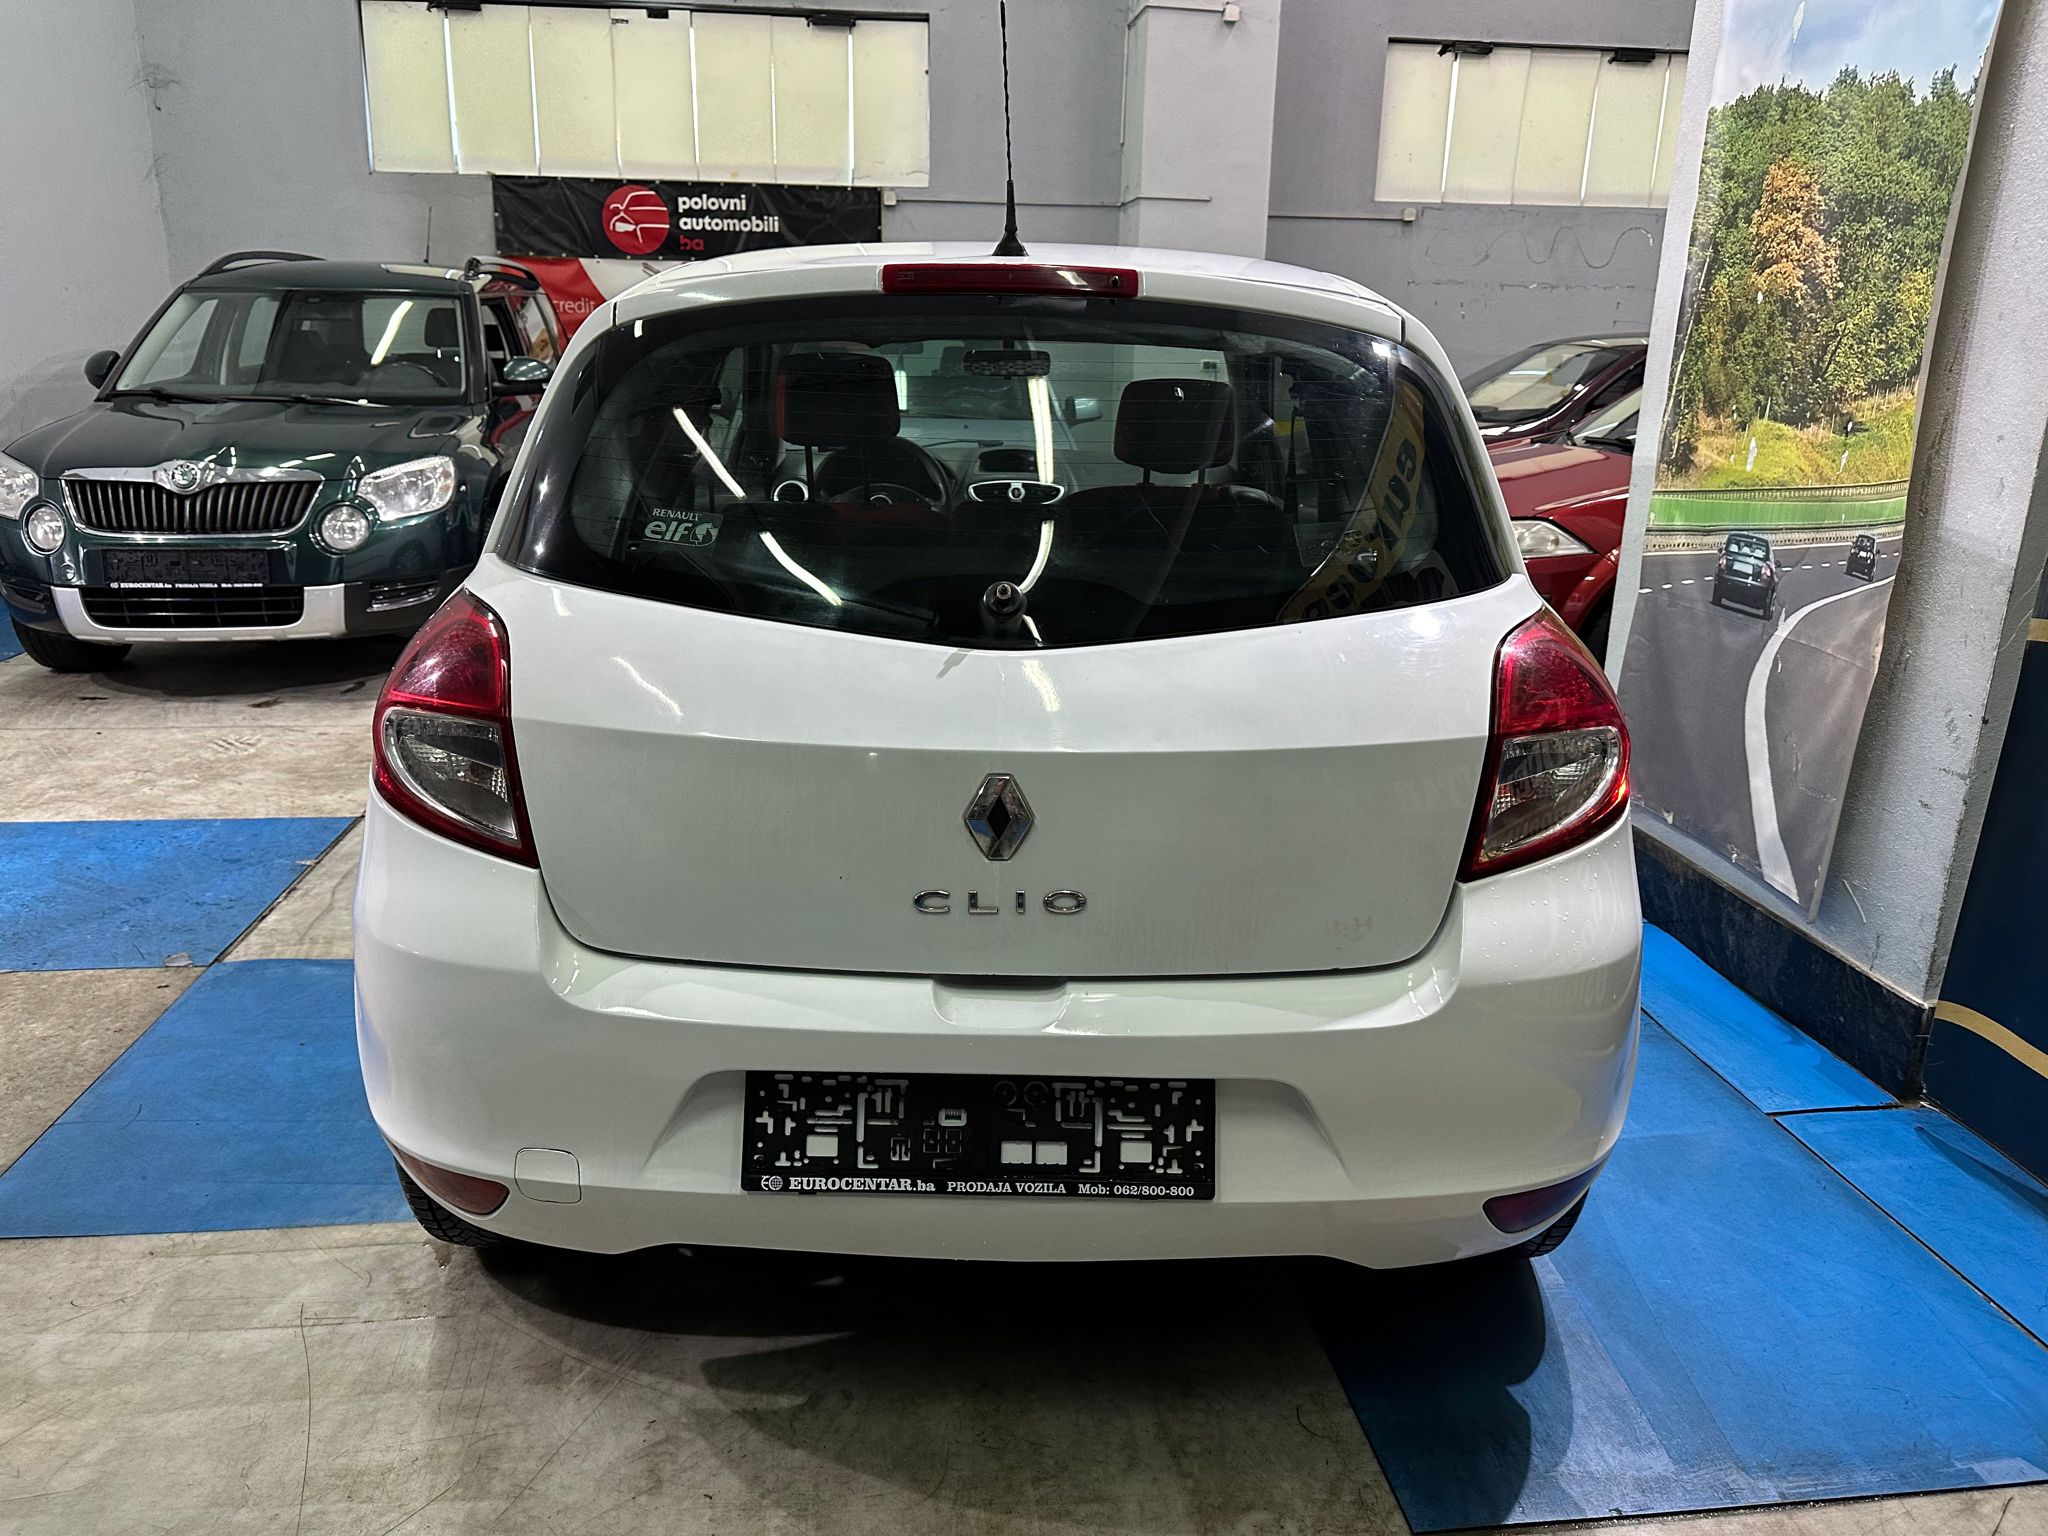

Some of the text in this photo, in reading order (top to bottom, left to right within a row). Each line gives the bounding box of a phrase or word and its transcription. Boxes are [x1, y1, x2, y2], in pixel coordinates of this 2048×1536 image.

[677, 193, 747, 213] polovni
[678, 215, 780, 233] automobili
[652, 507, 703, 521] RENAULT
[644, 520, 693, 541] elf
[913, 889, 1088, 915] CLIO
[788, 1176, 1195, 1197] EUROCENTAR.ba PRODAJA VOZILA Mob: 062/800-800
